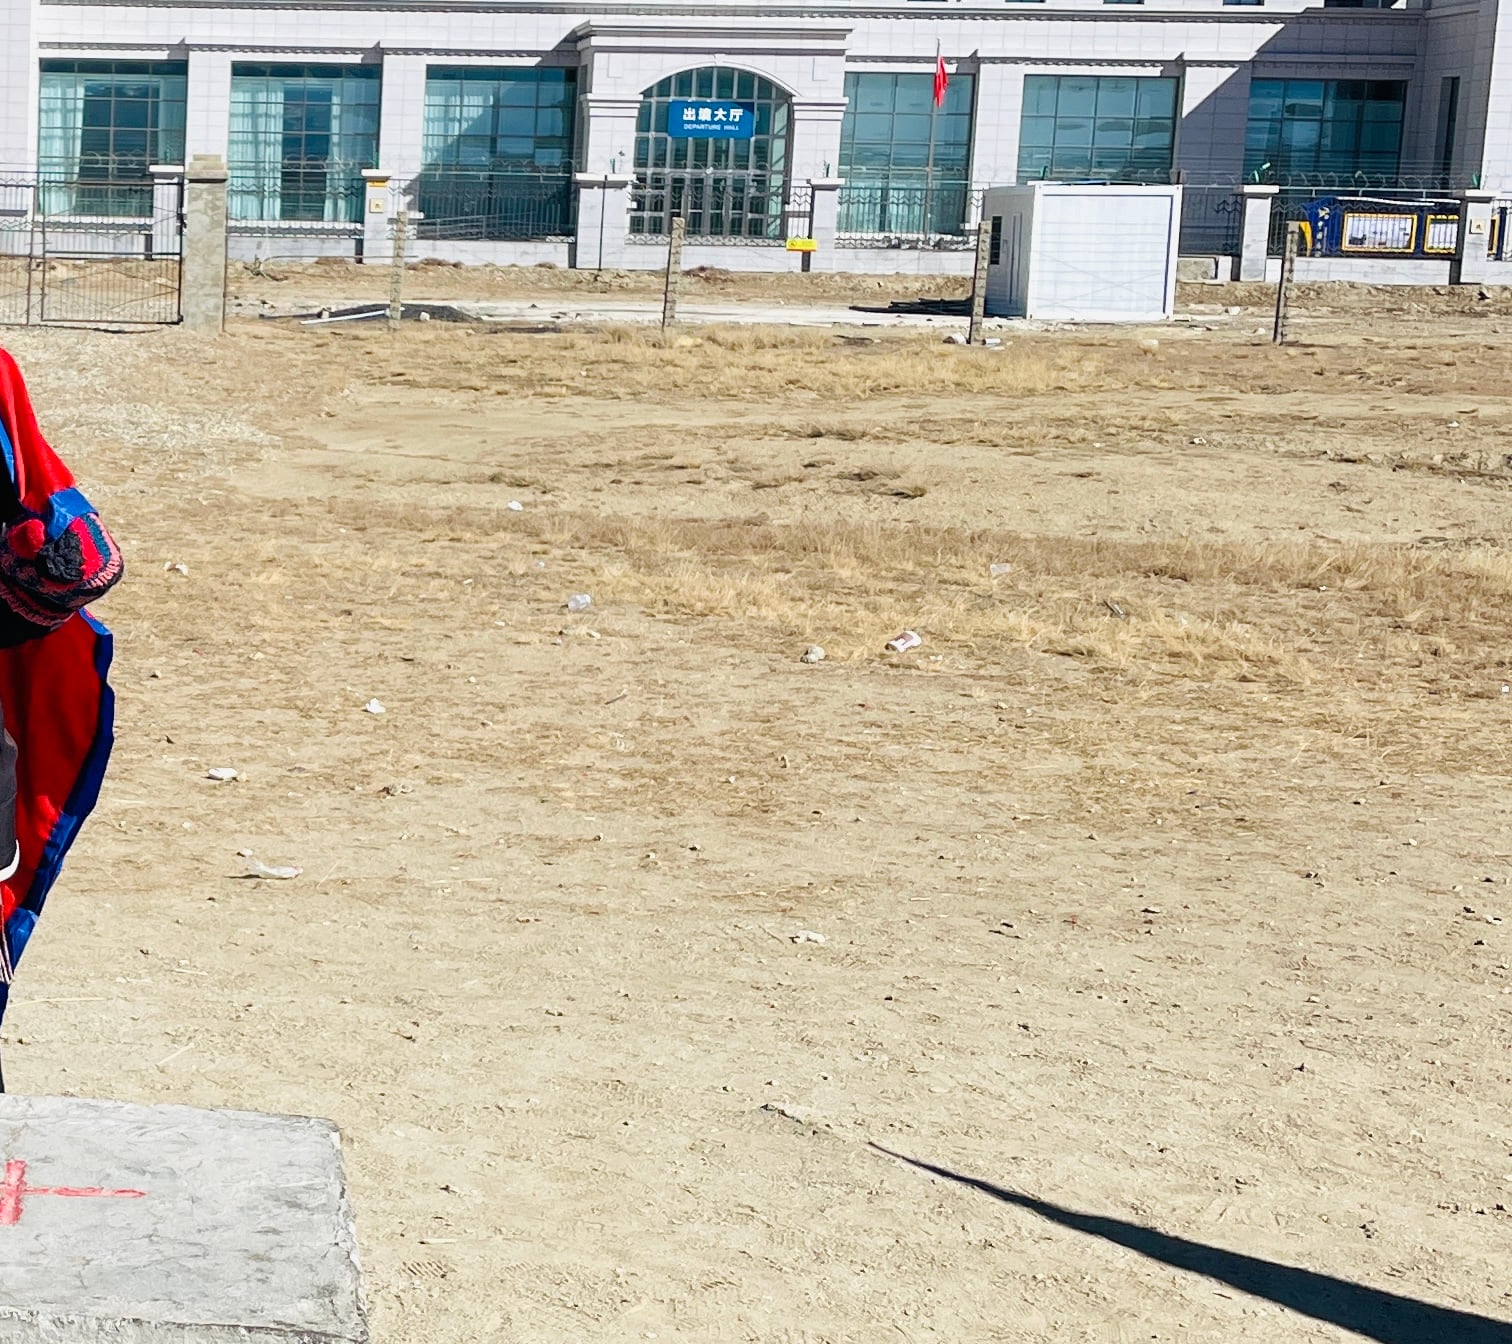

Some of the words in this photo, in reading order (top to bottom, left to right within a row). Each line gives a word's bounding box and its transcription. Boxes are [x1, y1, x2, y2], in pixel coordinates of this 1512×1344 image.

[682, 107, 744, 122] 出境大厅
[683, 123, 721, 131] DEPARTURE
